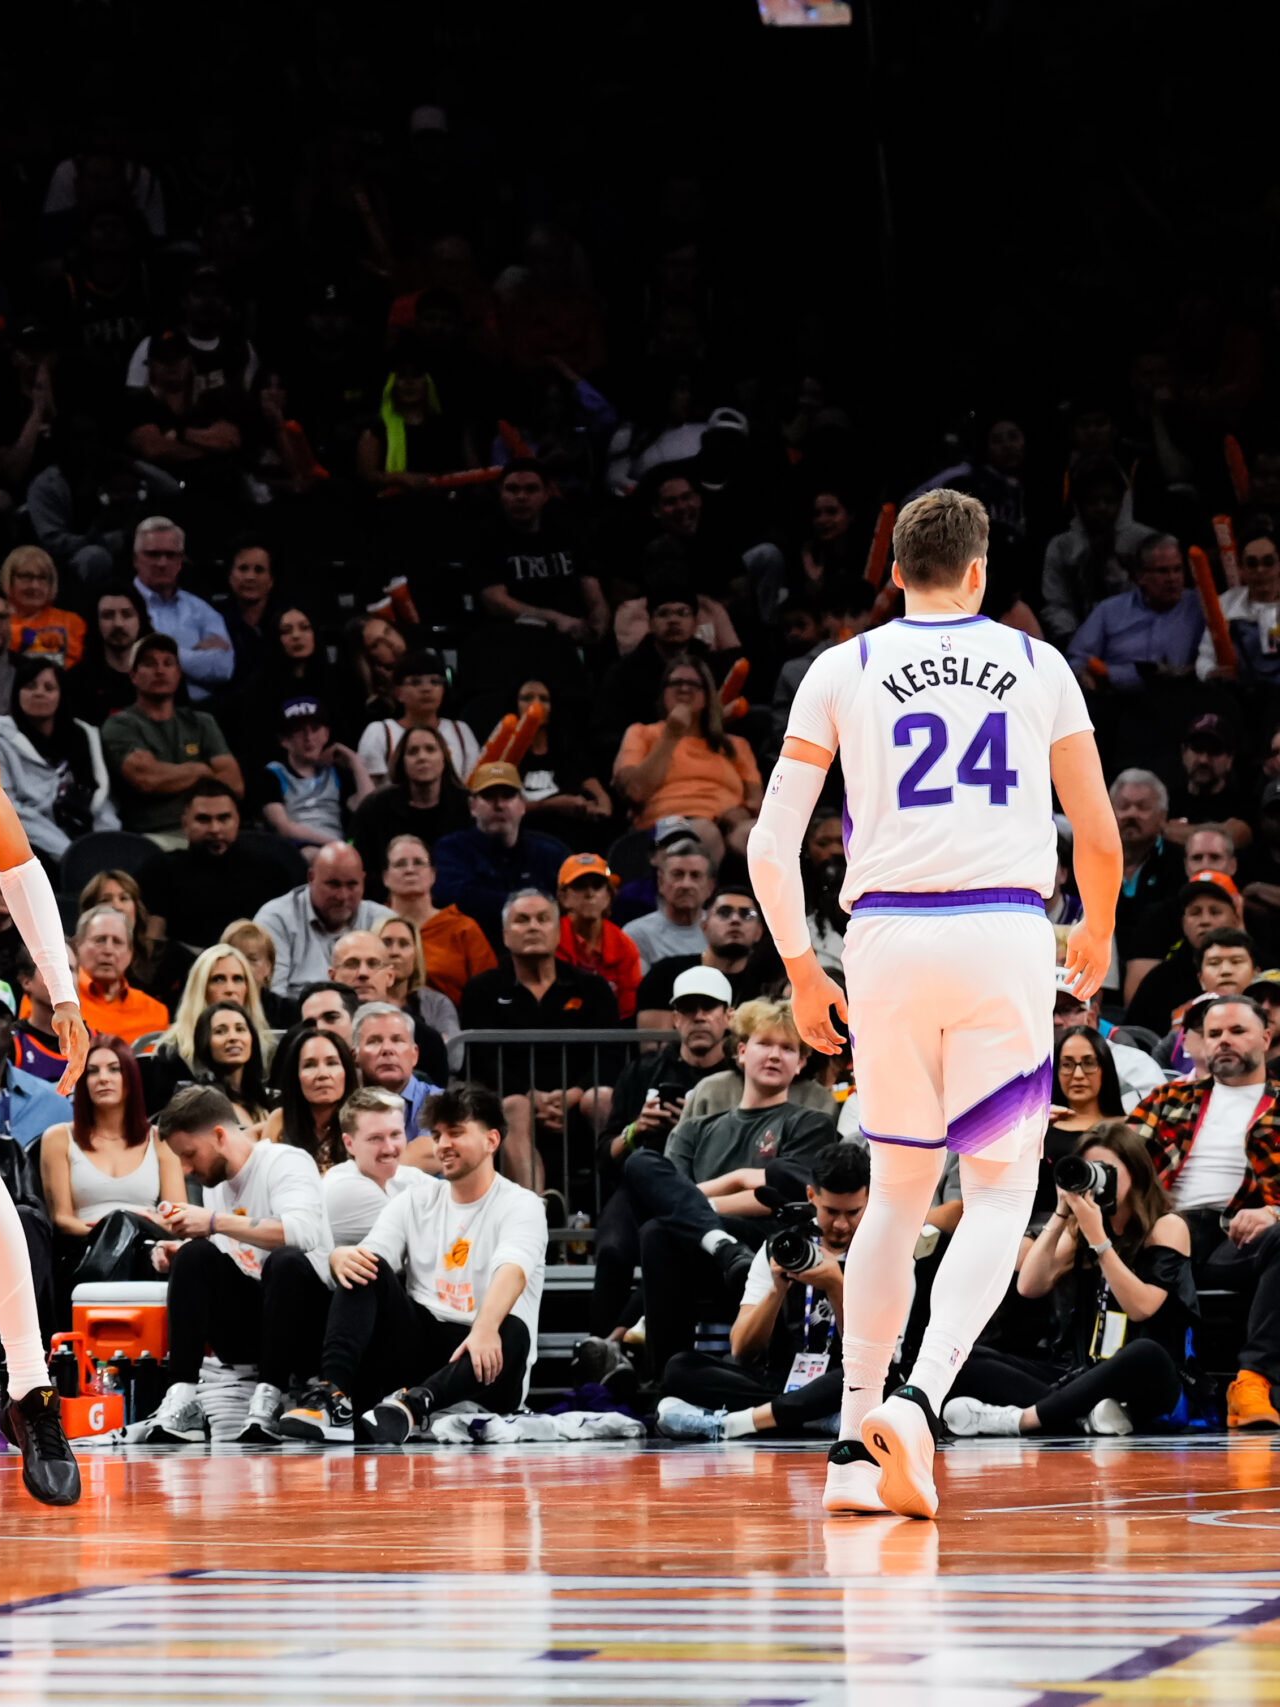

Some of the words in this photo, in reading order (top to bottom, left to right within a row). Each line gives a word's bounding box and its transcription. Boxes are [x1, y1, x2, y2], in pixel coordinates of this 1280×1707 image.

[881, 656, 1017, 704] KESSLER
[892, 711, 1019, 810] 24
[88, 1402, 105, 1431] G
